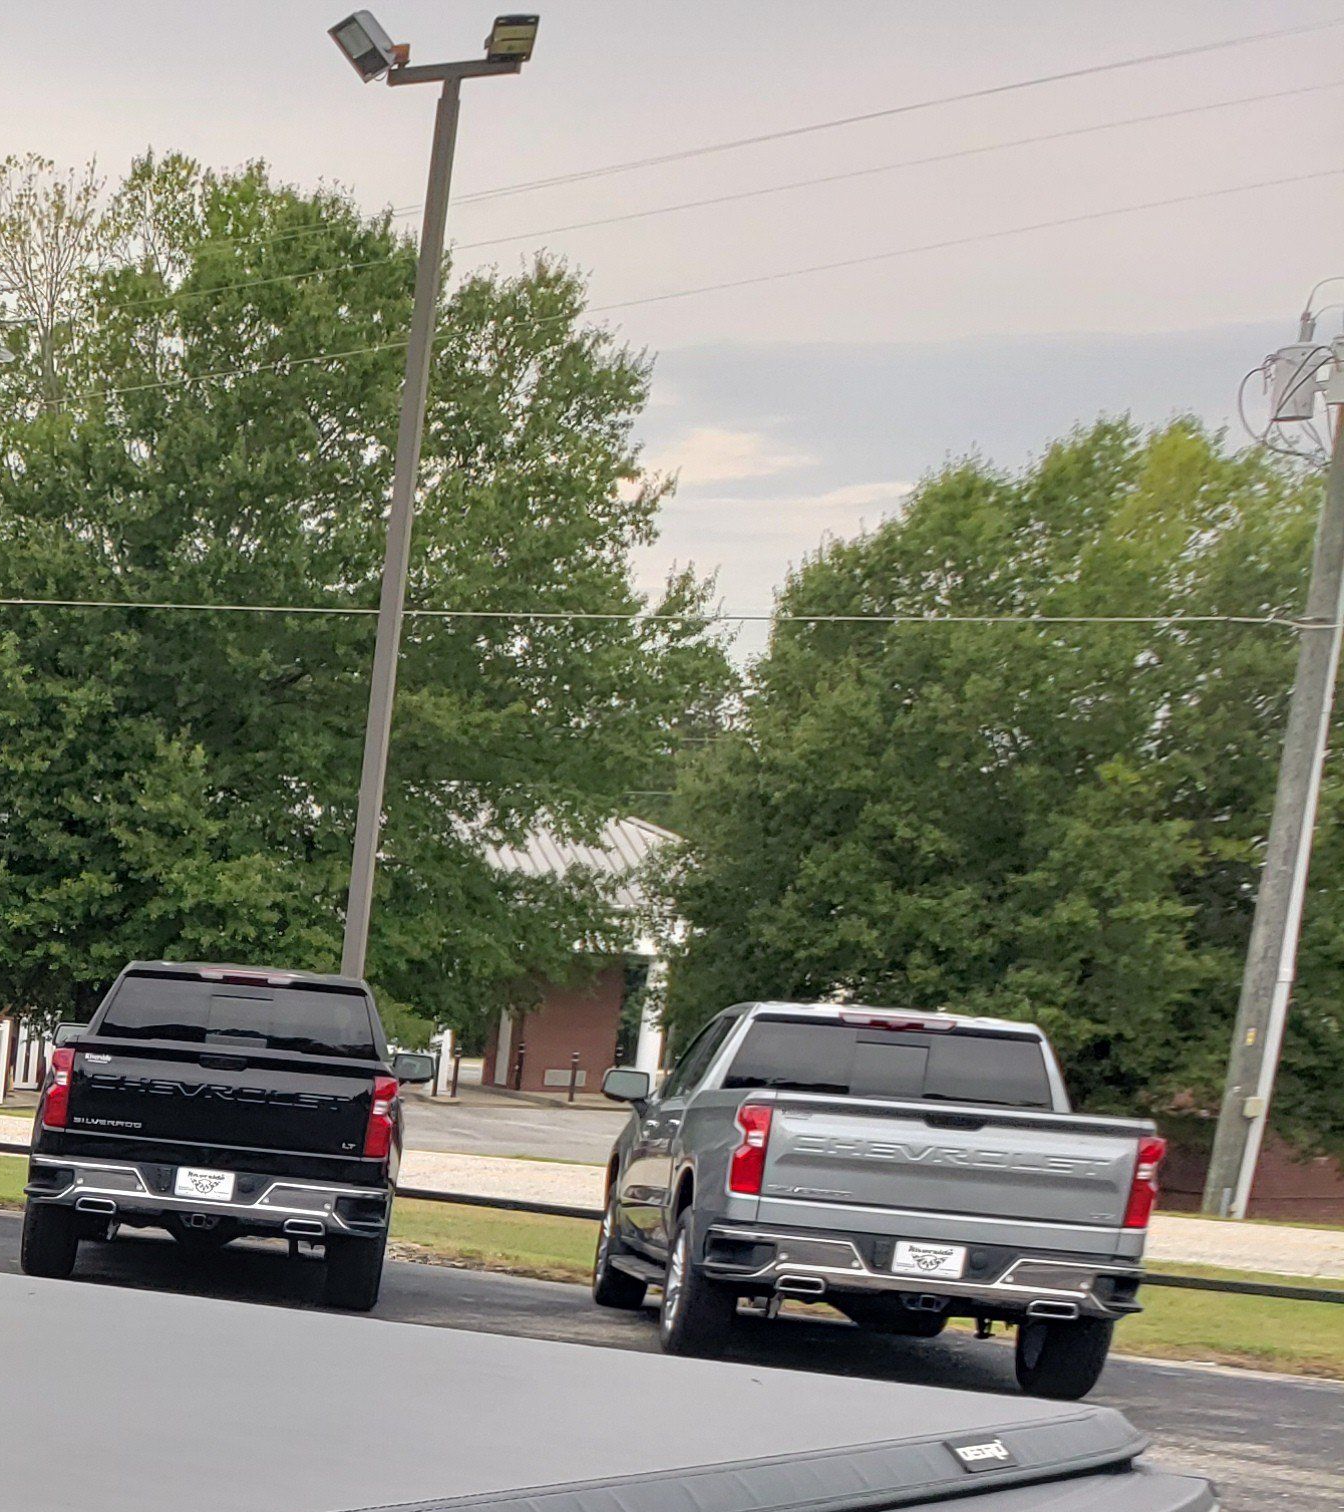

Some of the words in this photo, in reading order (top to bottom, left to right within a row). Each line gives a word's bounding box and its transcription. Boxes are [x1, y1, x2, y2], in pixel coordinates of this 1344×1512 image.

[91, 1073, 351, 1111] CHEVROLET
[73, 1117, 142, 1129] SILVERADO
[793, 1134, 1111, 1176] CHEVROLET
